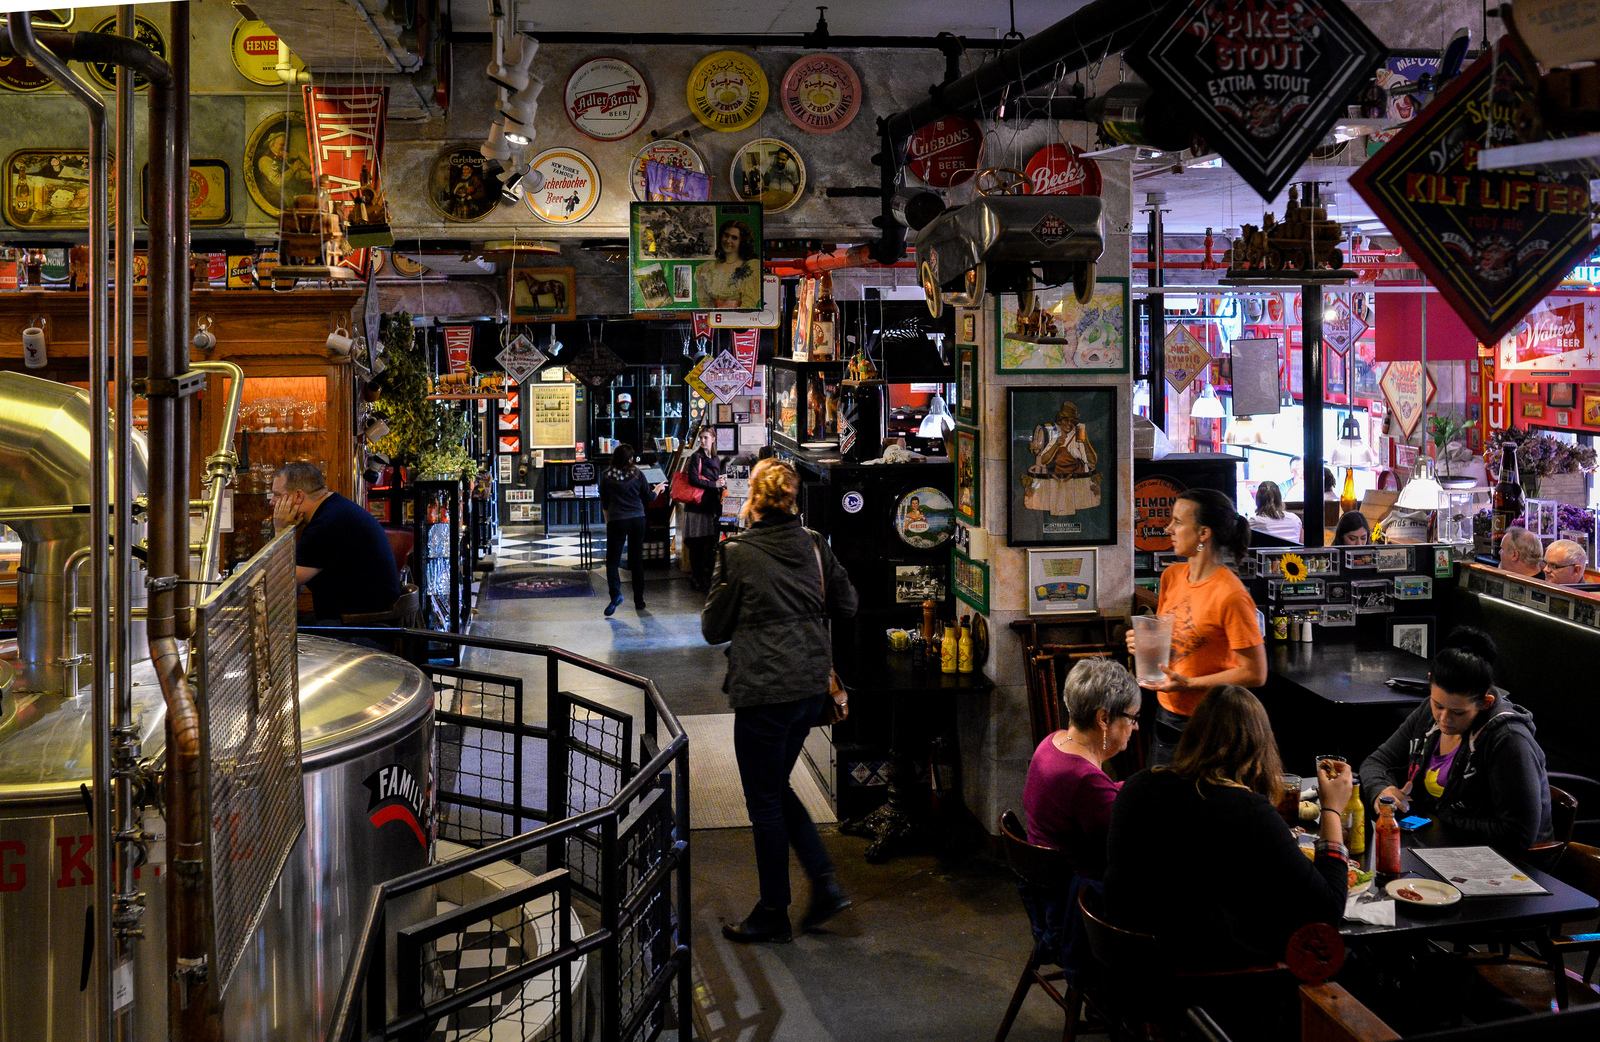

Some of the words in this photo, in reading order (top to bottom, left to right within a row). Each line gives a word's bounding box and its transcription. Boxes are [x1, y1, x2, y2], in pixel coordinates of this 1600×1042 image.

[1224, 8, 1292, 39] PIKE
[1216, 42, 1304, 71] STOUT
[1207, 74, 1257, 97] EXTRA
[1262, 73, 1311, 94] STOUT
[578, 93, 608, 111] Adler
[696, 95, 713, 119] DRINK
[715, 112, 743, 125] FERIDA
[743, 91, 760, 119] ALWAYS
[789, 97, 805, 120] DRINK
[806, 114, 834, 126] FERIDA
[836, 94, 852, 119] ALWAYS
[316, 93, 380, 161] PIKE
[911, 128, 971, 156] GIBBONS
[551, 161, 562, 169] NEW
[552, 168, 574, 179] FAMOUS
[938, 160, 966, 170] BEER
[1031, 160, 1087, 195] Beck's
[543, 177, 588, 190] ickerbocker
[1405, 170, 1471, 207] KILT
[1479, 177, 1590, 216] LIFTER
[546, 191, 564, 204] Beer
[1041, 227, 1063, 235] PIKE
[1352, 255, 1380, 263] ATNEYS
[715, 313, 722, 323] 6
[447, 329, 472, 355] PIKE
[1523, 316, 1576, 350] Walter's
[1556, 338, 1580, 348] BEER
[1488, 380, 1504, 429] HU
[1135, 497, 1177, 507] ELMON
[1148, 508, 1171, 518] BEE
[379, 766, 425, 818] FAMILY
[0, 840, 26, 892] G
[56, 835, 94, 888] K
